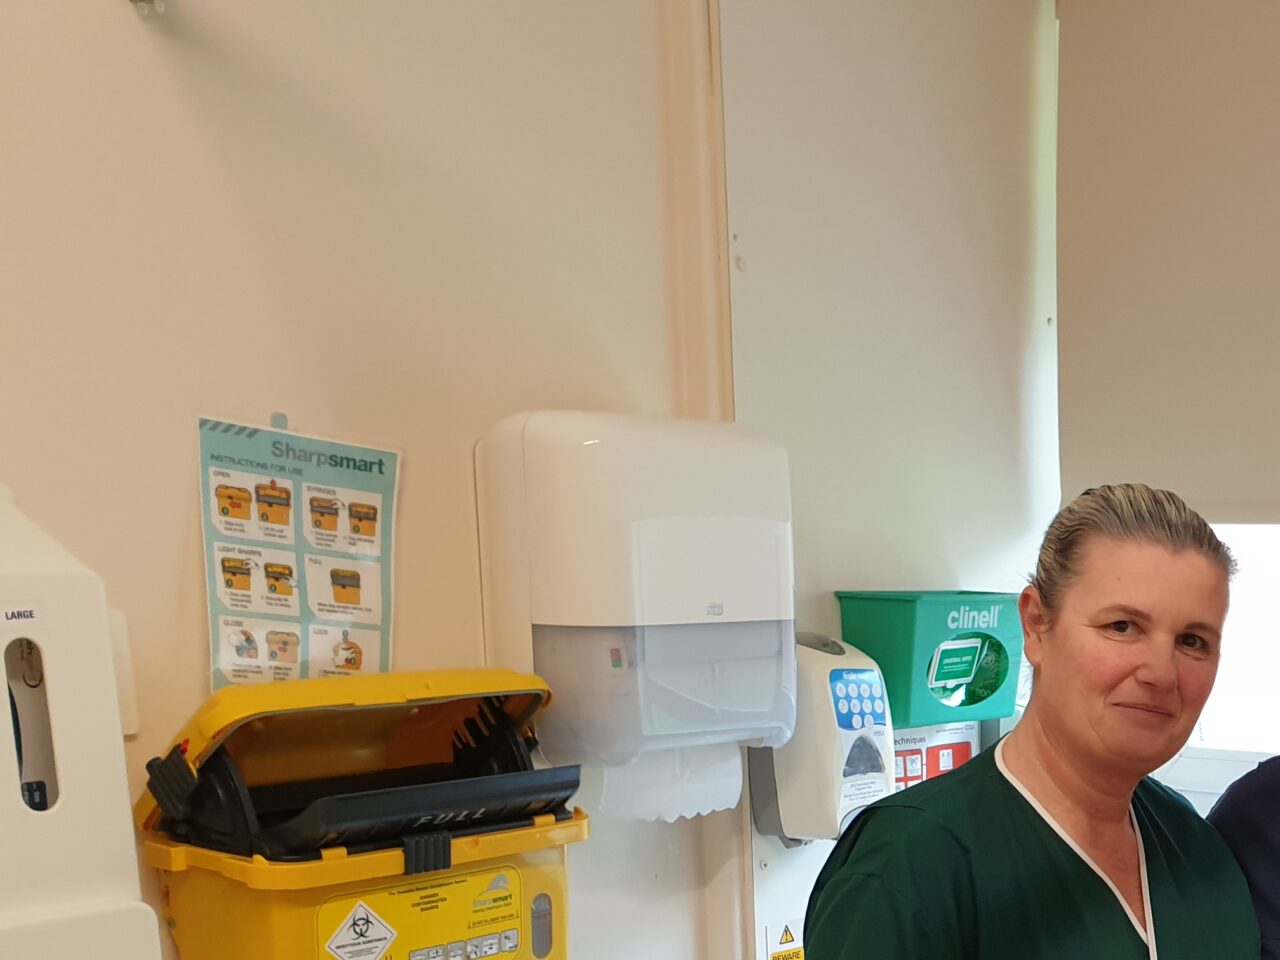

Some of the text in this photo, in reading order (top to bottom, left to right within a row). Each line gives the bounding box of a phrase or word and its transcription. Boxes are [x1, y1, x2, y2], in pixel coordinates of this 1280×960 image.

[210, 453, 304, 476] INSTRUCTIONS FOR USE
[271, 440, 385, 475] Sharpsmart
[5, 610, 36, 620] LARGE
[947, 605, 999, 630] clinell
[894, 736, 926, 746] echniques
[412, 808, 487, 827] FULL
